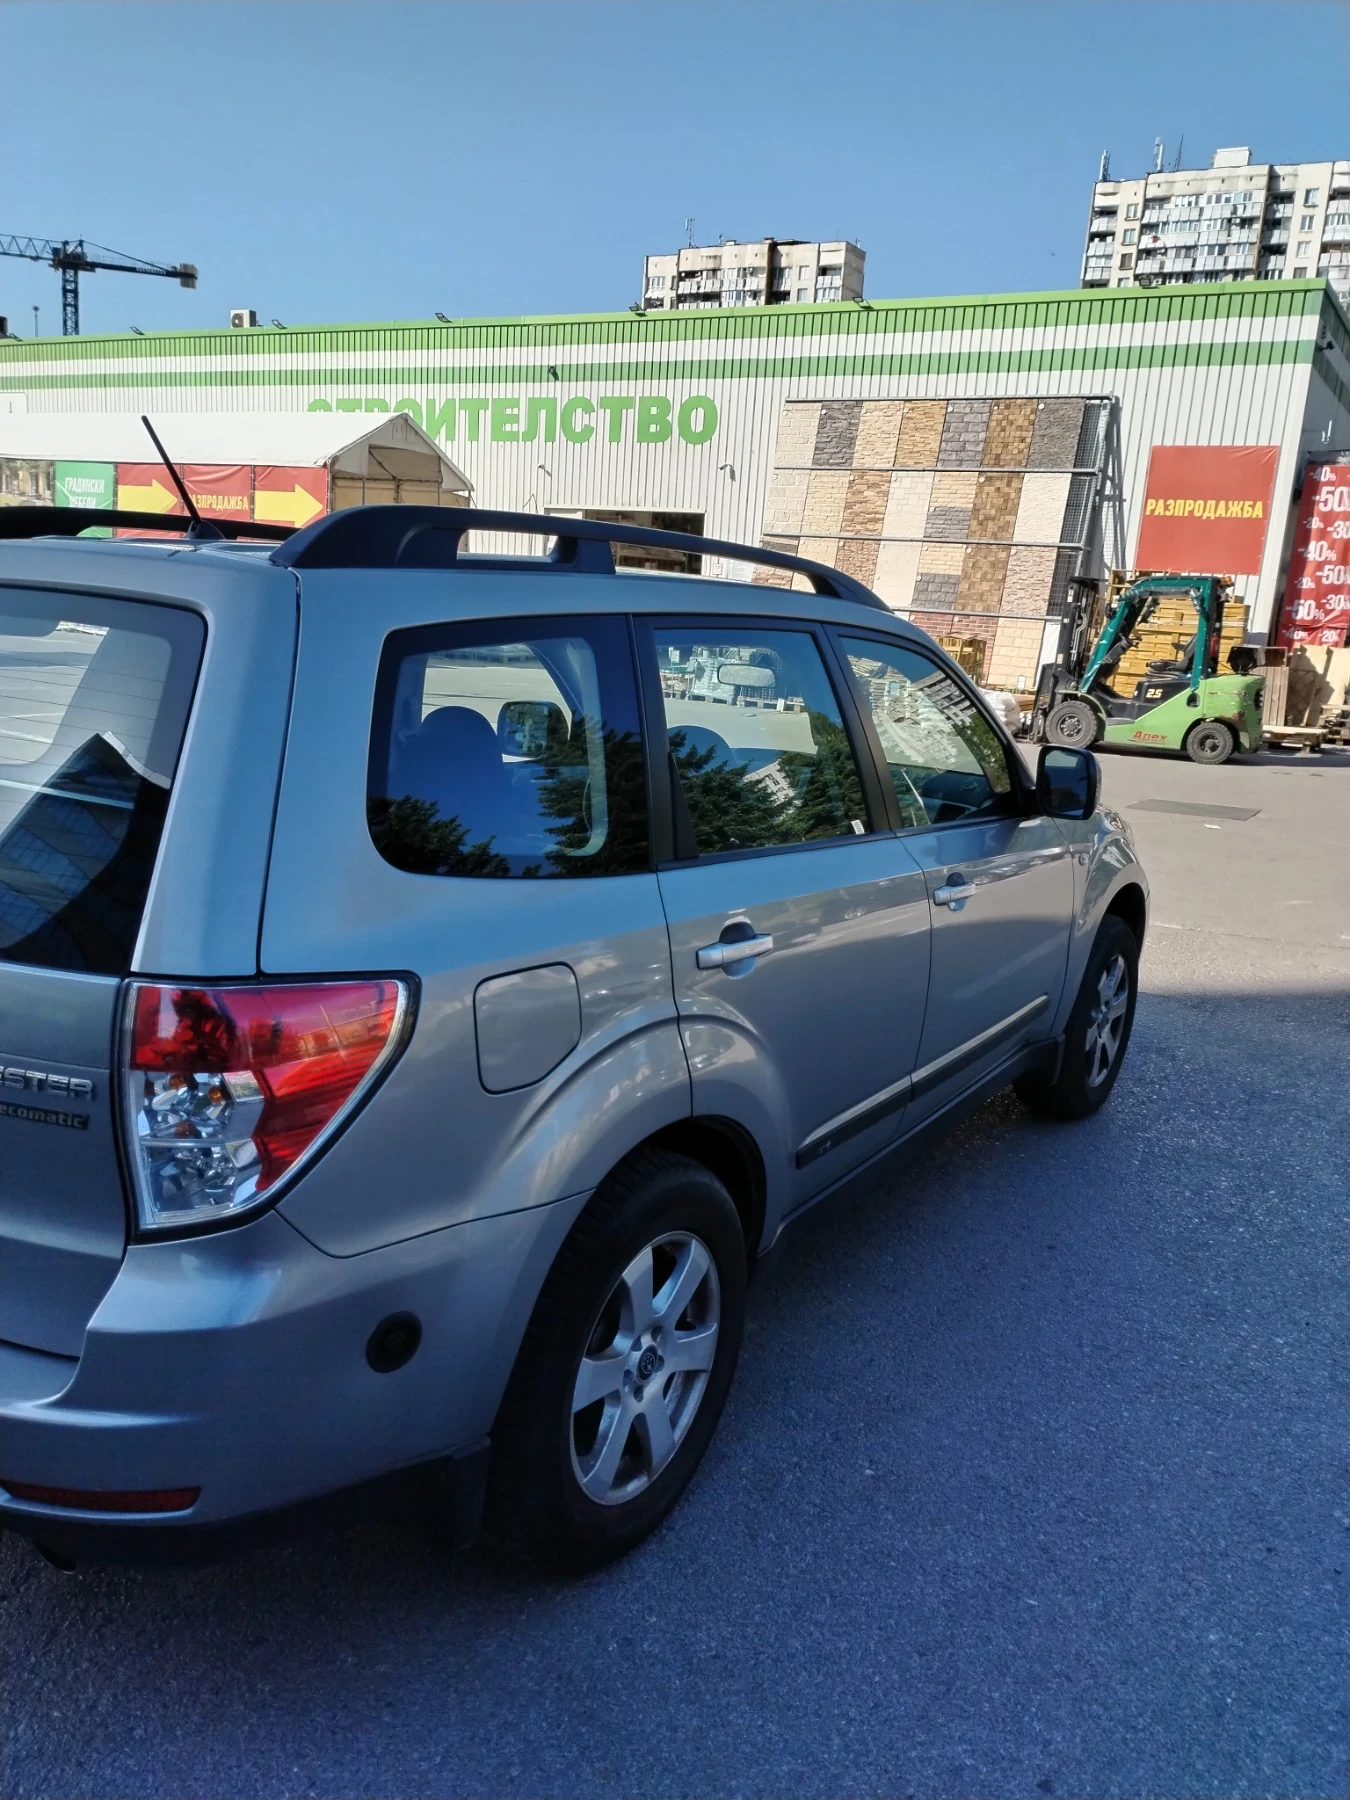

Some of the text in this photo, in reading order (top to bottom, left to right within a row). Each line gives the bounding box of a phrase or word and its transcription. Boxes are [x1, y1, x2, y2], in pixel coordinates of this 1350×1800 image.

[307, 395, 719, 445] ИТЕЛСТВО
[65, 477, 104, 494] ГРАДИНСКИ
[191, 494, 249, 512] АЗПРОДАЖБА
[1145, 498, 1263, 520] РАЗПРОДАЖБА
[1312, 486, 1350, 512] -50
[1298, 541, 1337, 562] -40%
[1286, 599, 1325, 621] -50%
[1146, 689, 1163, 699] 25
[0, 1065, 94, 1101] STER
